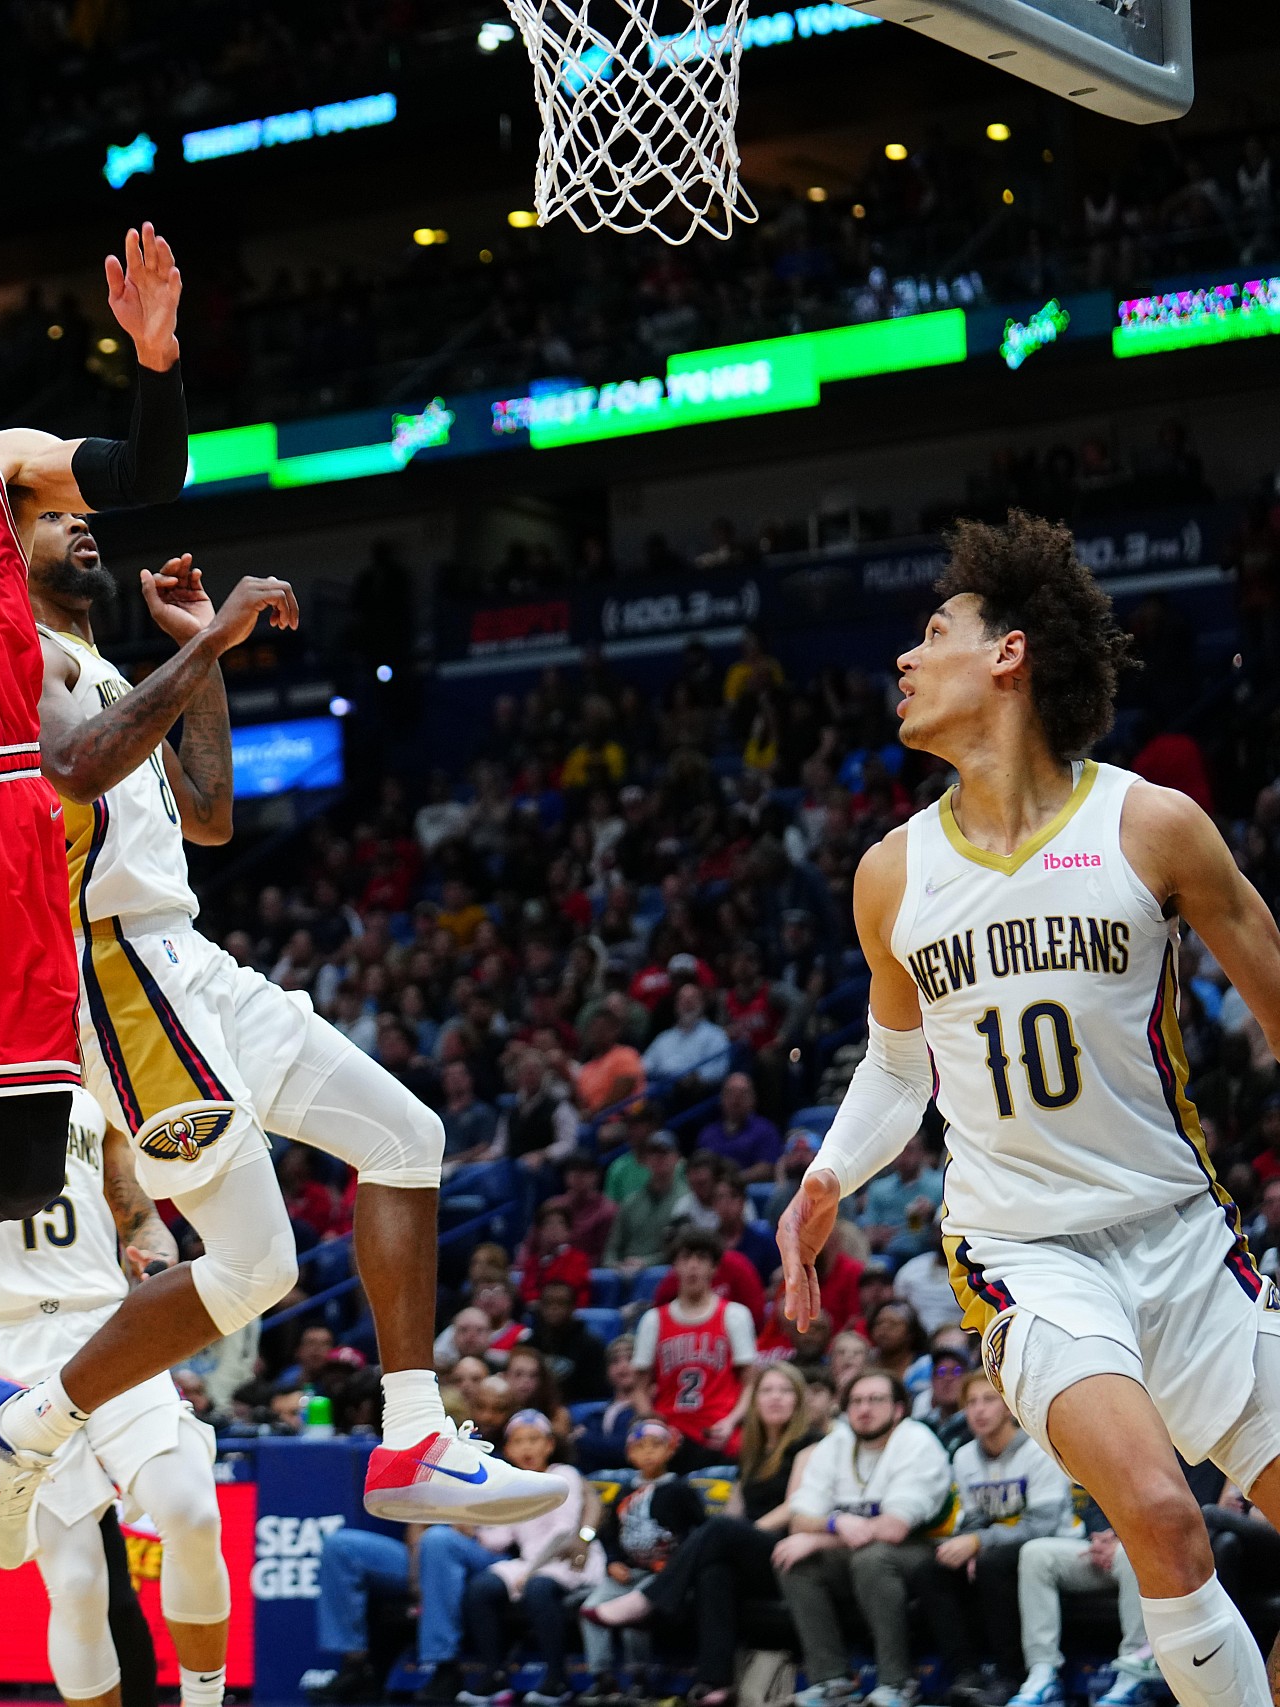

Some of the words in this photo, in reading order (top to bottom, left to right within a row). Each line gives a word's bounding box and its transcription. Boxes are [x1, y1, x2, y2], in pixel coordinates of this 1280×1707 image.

[1043, 853, 1101, 870] ibotta
[907, 928, 978, 1005] NEW
[986, 915, 1130, 978] ORLEANS
[974, 999, 1082, 1120] 10
[674, 1366, 706, 1412] 2
[255, 1515, 346, 1558] SEAT
